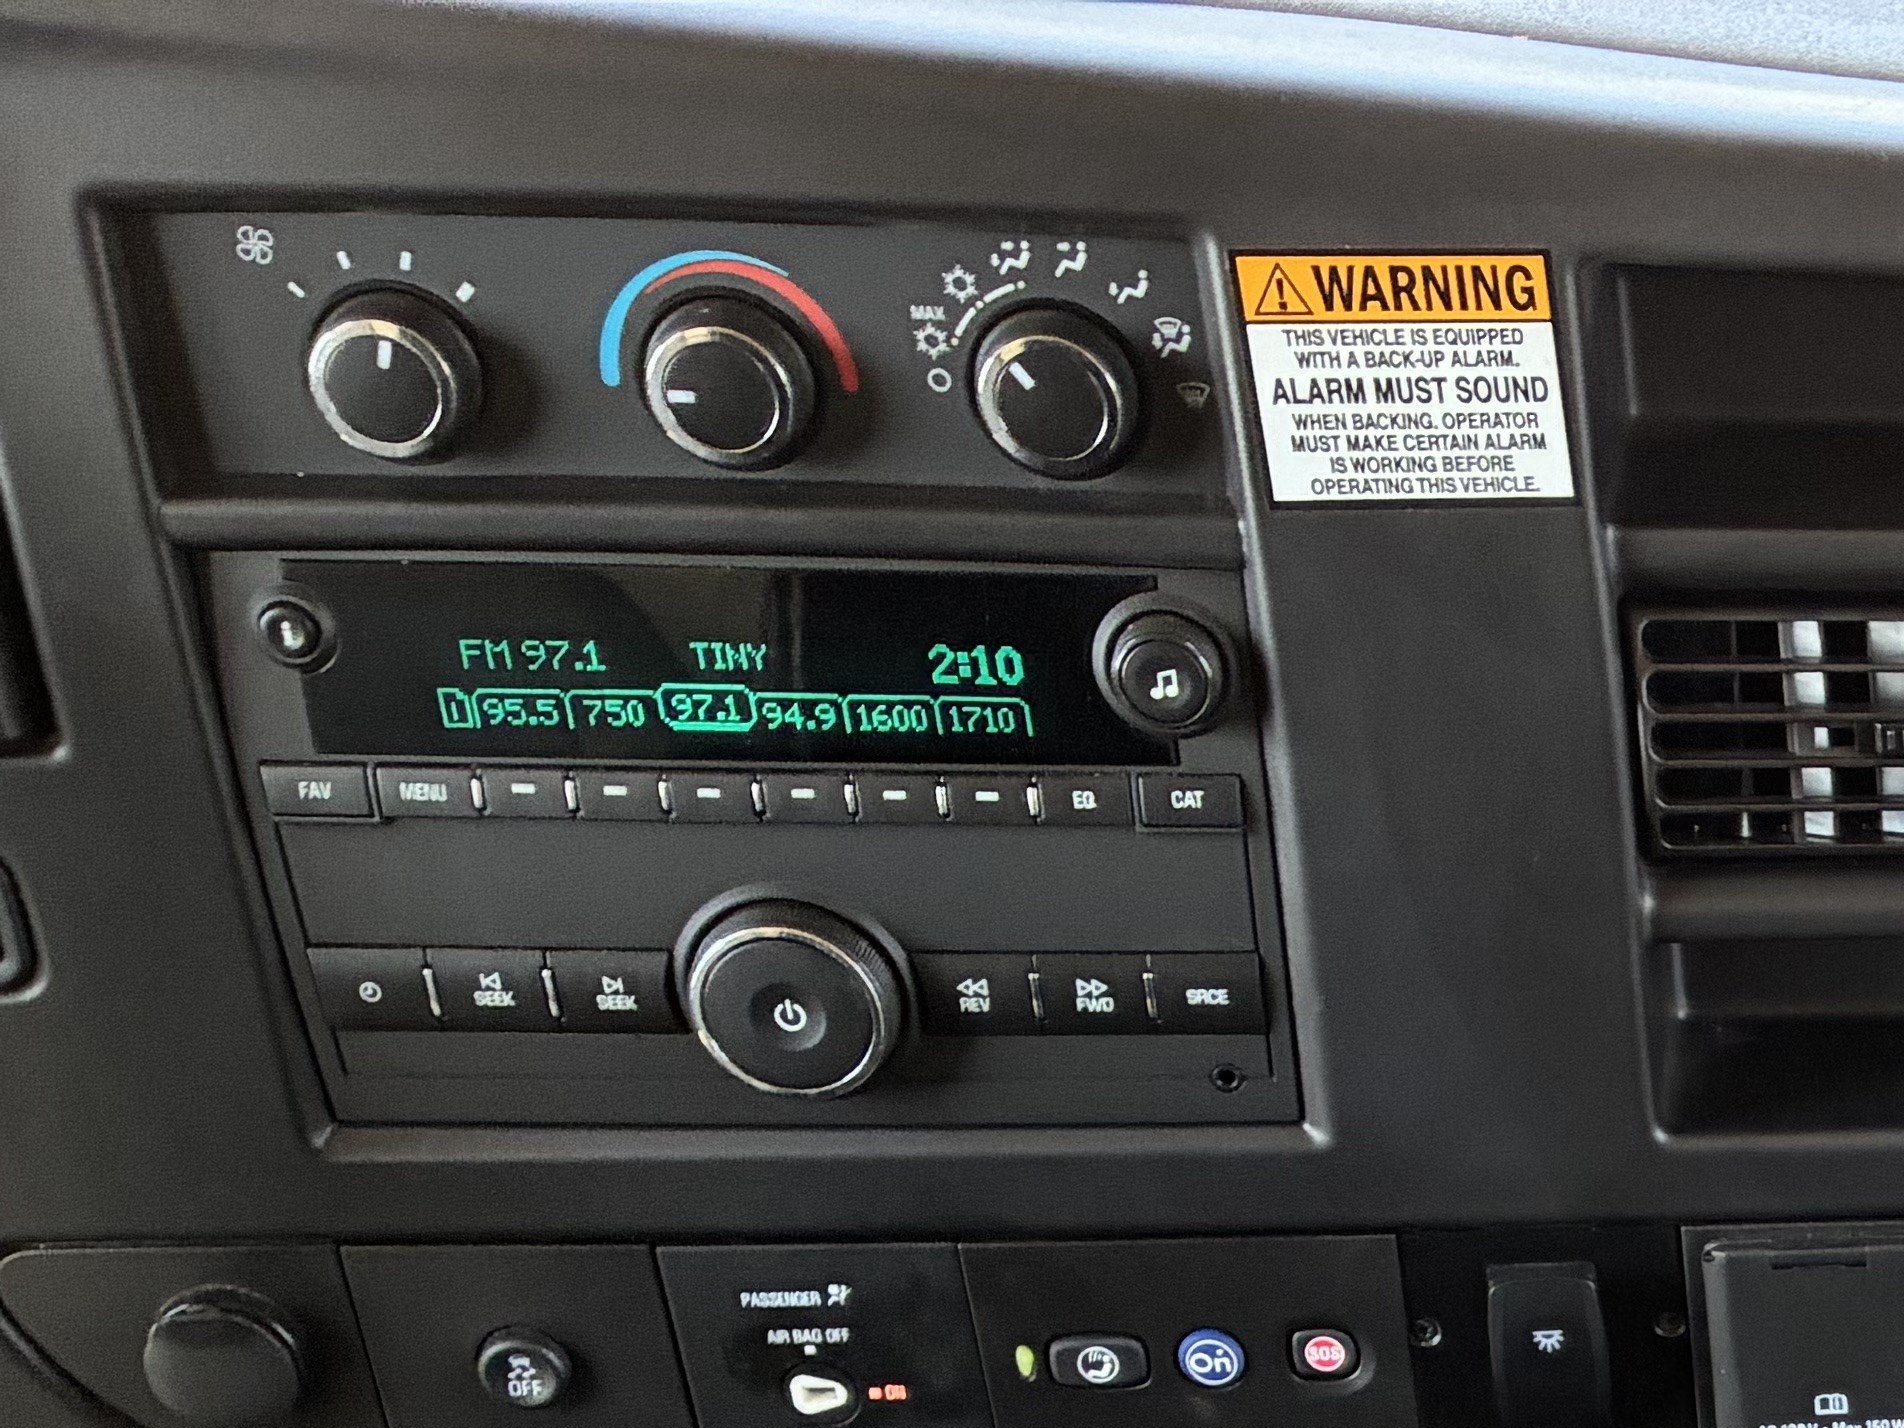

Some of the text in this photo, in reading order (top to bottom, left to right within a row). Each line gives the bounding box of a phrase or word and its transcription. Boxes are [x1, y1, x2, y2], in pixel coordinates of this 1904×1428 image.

[1311, 263, 1538, 313] WARNING
[910, 305, 946, 322] MAX
[1282, 328, 1523, 346] THIS VEHICLE IS EQUIPPED
[1296, 351, 1520, 368] WITH A BACK-UP ALARM.
[1272, 376, 1548, 405] ALARM MUST SOUND
[1292, 412, 1539, 430] WHEN BACKING. OPERATOR
[1291, 433, 1547, 453] MUST MAKE CERTAIN ALARM
[1330, 456, 1515, 473] IS WORKING BEFORE
[1310, 477, 1541, 495] OPERATING THIS VEHICLE.
[459, 639, 607, 672] FM 97.1
[689, 642, 766, 671] TINY
[928, 644, 1024, 686] 2:10
[481, 697, 560, 726] 95.5
[582, 699, 646, 728] 750
[670, 695, 741, 723] 97.1
[761, 701, 837, 729] 94.9
[856, 704, 925, 733] 1600
[949, 705, 1015, 733] 1710
[299, 781, 331, 801] FAV
[400, 783, 447, 803] MENU
[1073, 791, 1096, 810] EQ
[1171, 791, 1204, 810] CAT
[474, 990, 515, 1008] SEEK
[596, 993, 637, 1011] SEEK
[959, 993, 989, 1013] REV
[1077, 995, 1114, 1013] FWD
[1187, 989, 1229, 1006] SRCE
[740, 1291, 822, 1308] PASSENGER
[767, 1328, 850, 1344] AIR BAG OFF
[1308, 1345, 1343, 1362] SOS
[508, 1380, 542, 1397] OFF
